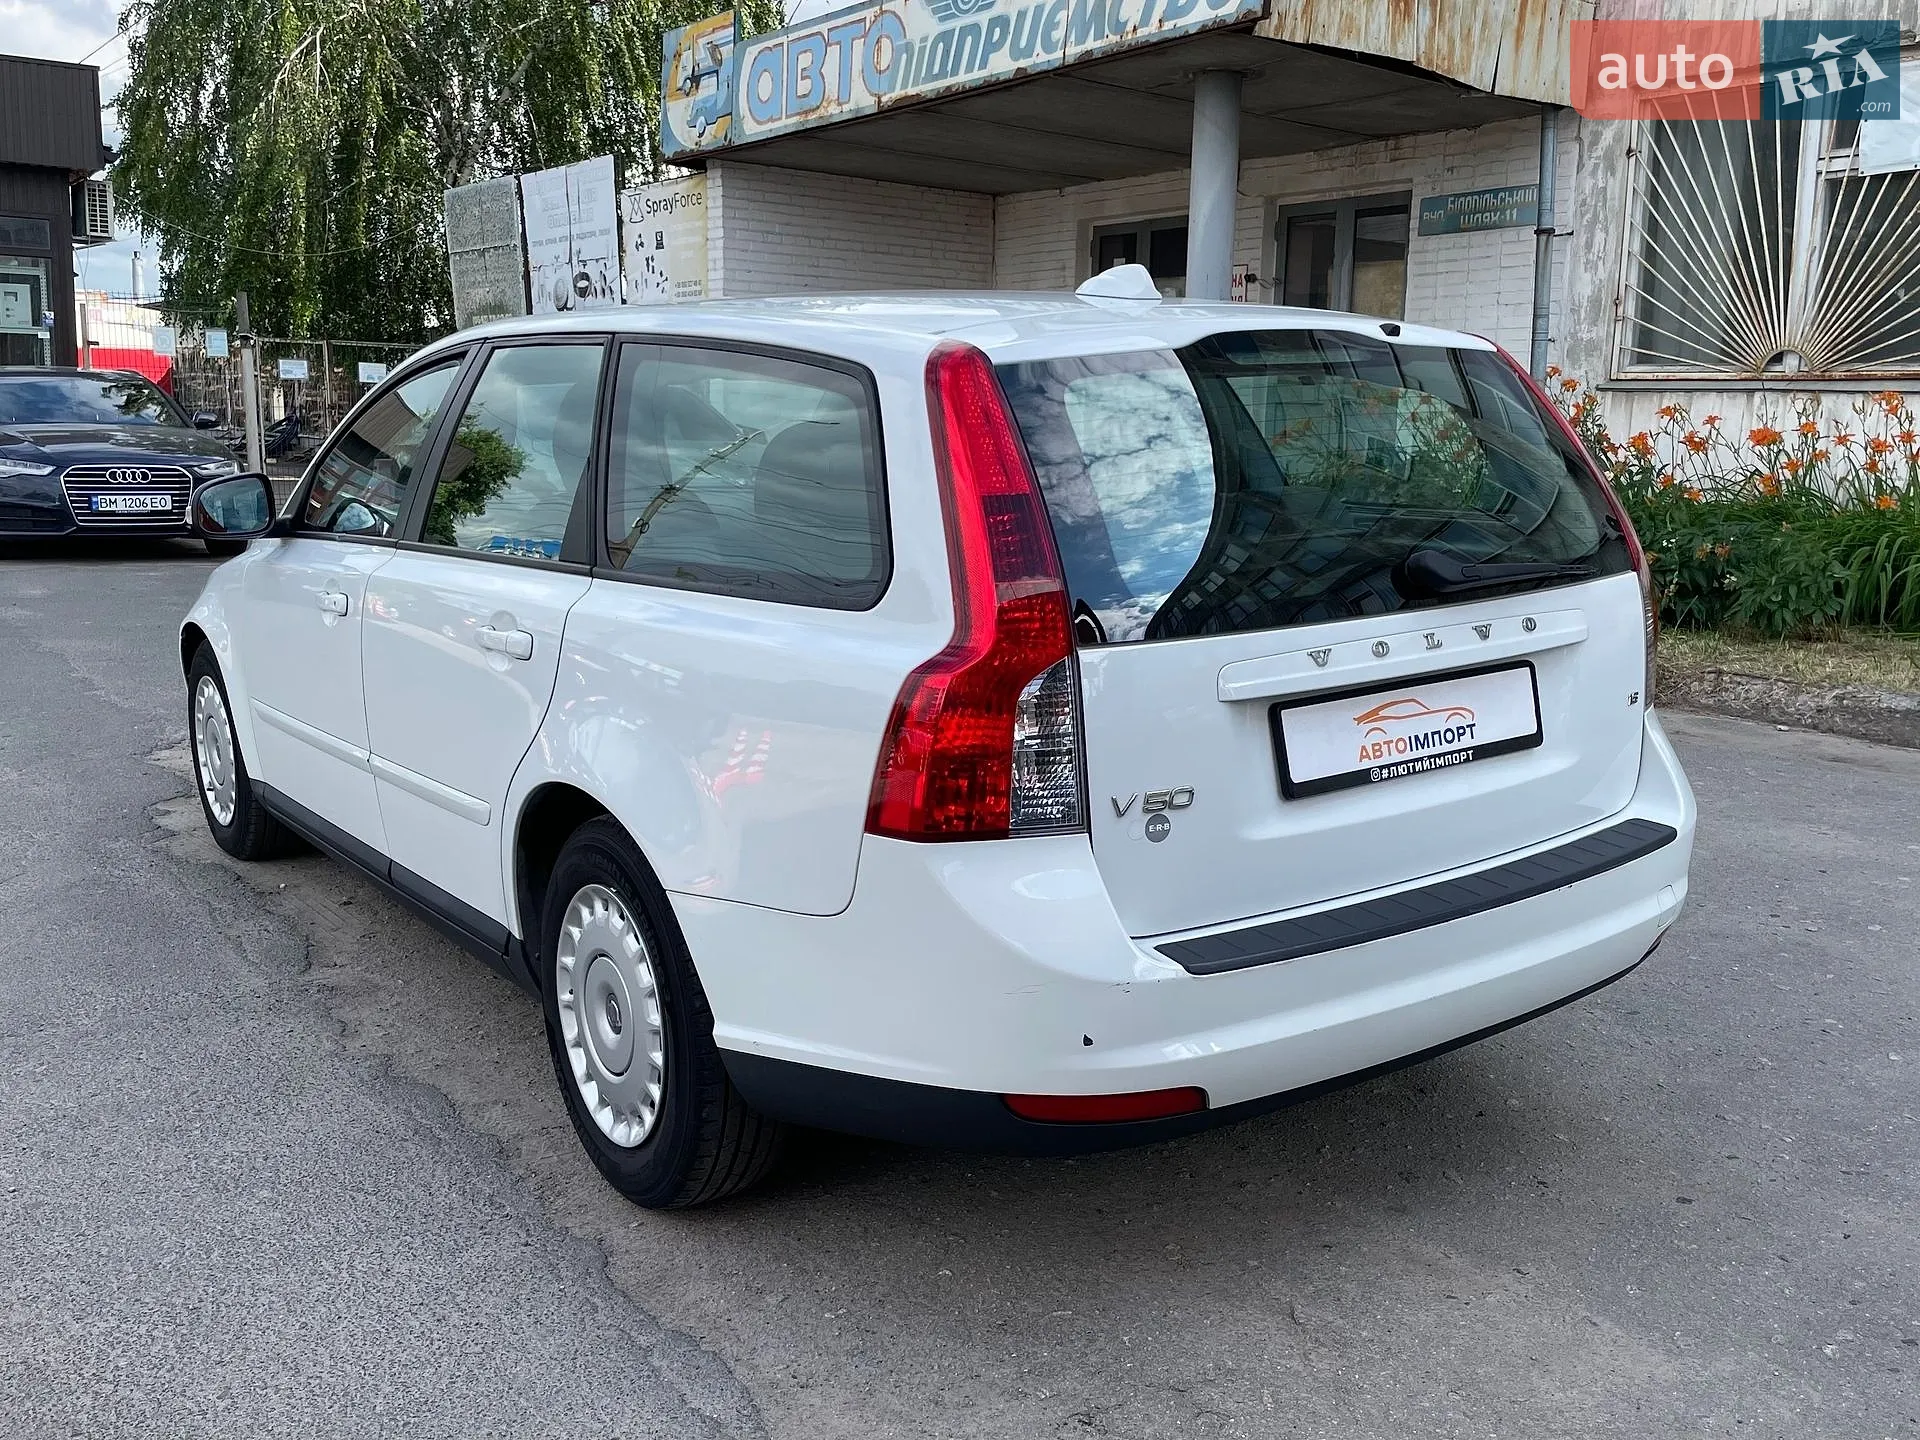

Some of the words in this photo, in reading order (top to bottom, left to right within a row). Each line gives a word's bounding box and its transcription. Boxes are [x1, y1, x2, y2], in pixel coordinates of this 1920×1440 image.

[645, 191, 703, 218] SprayForce
[100, 497, 118, 509] BM
[121, 497, 149, 509] 1206
[150, 497, 167, 508] EO
[1306, 616, 1538, 668] VOLVO
[1357, 722, 1477, 763] АВТОІМПОРТ
[1110, 784, 1196, 818] V50
